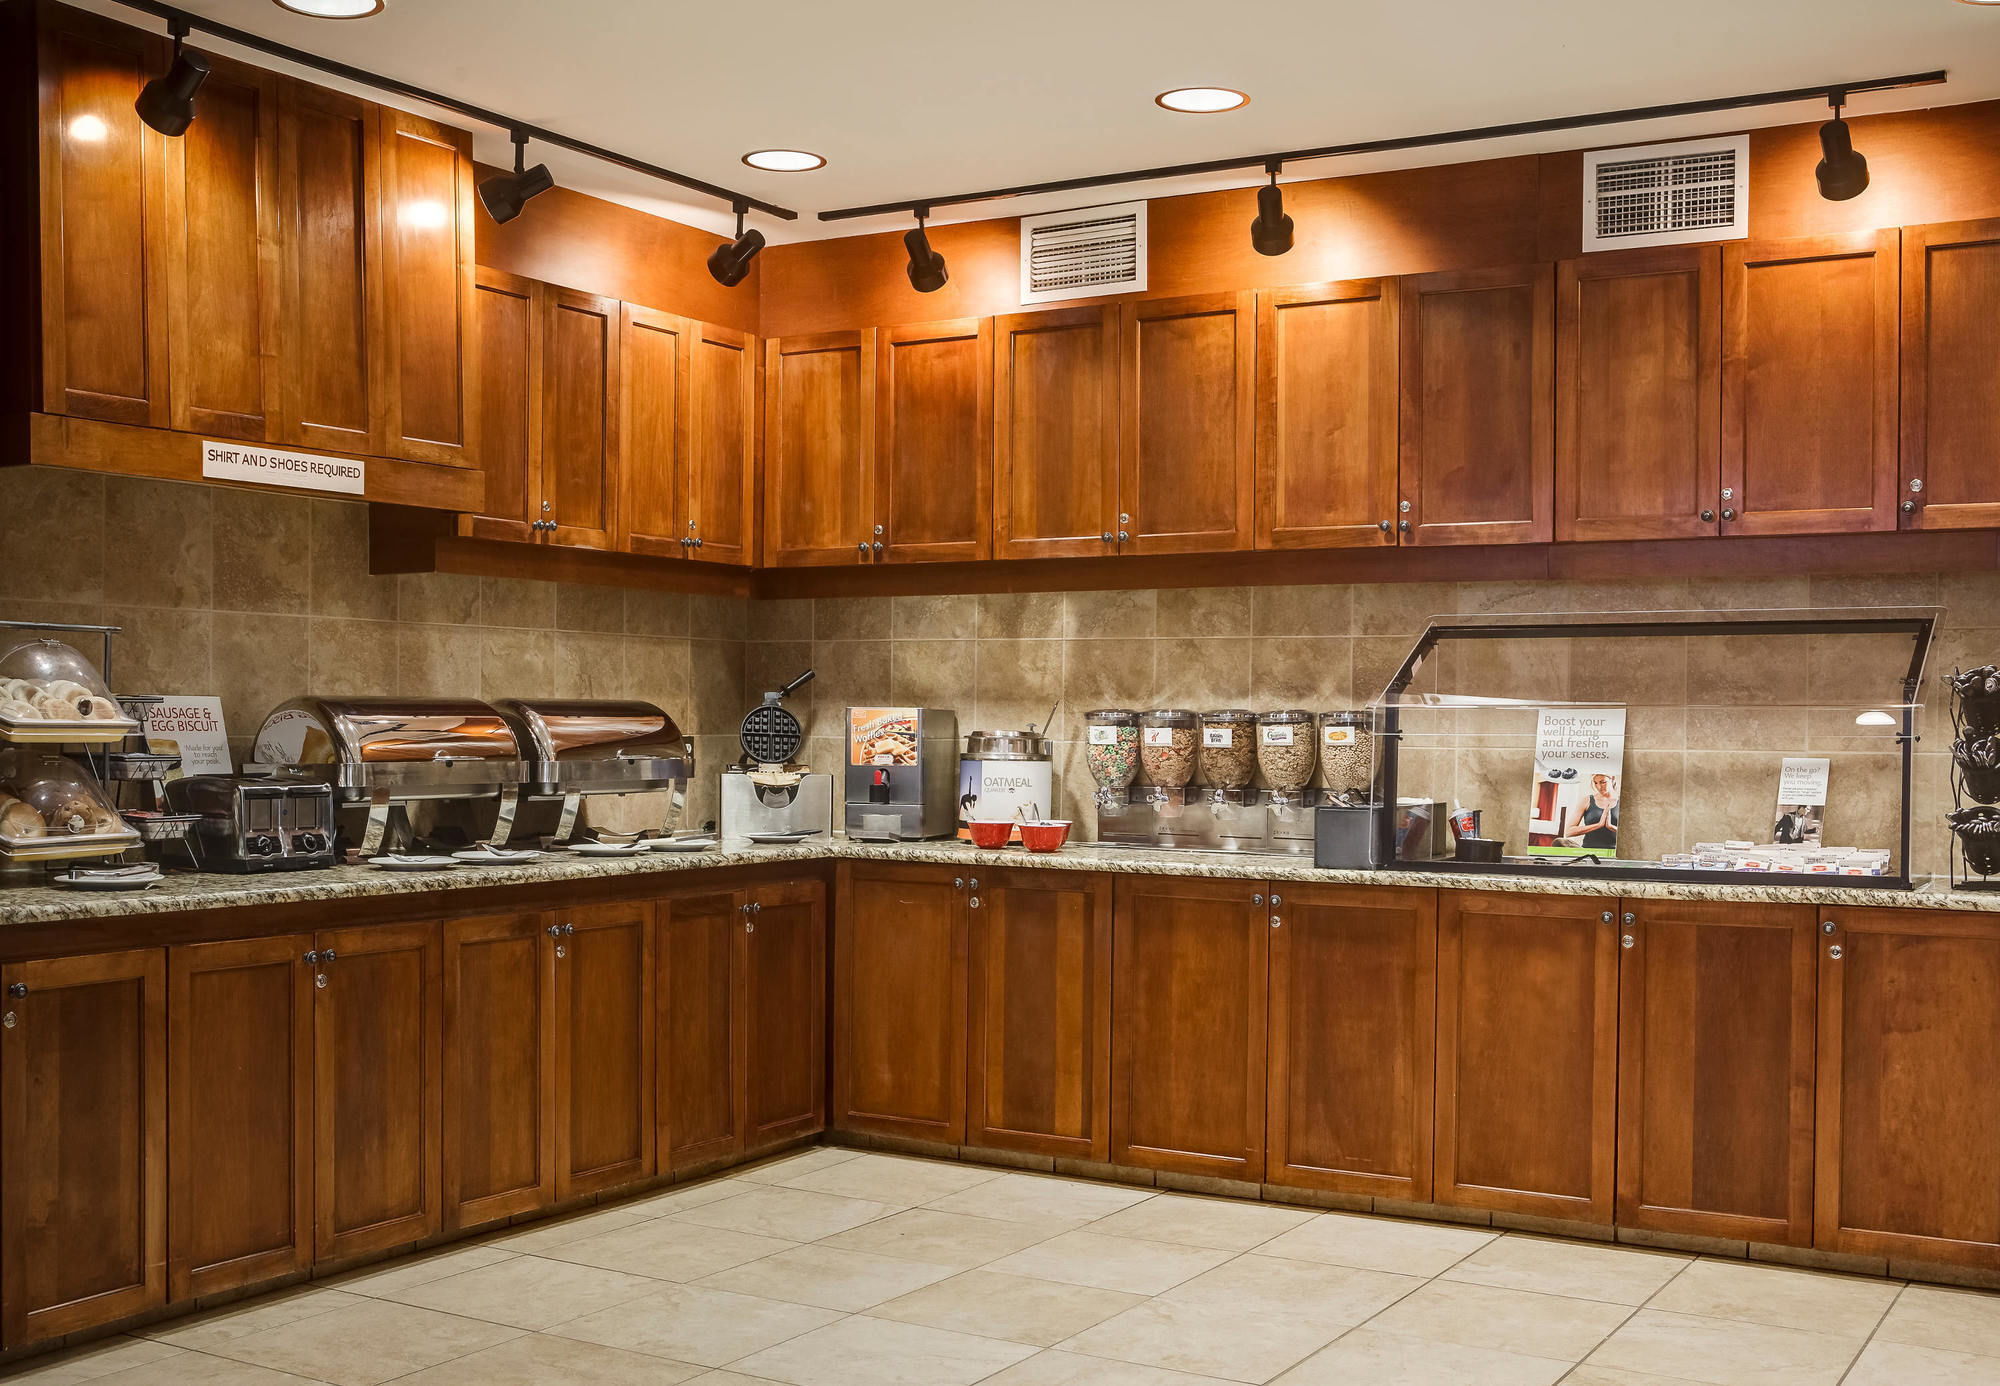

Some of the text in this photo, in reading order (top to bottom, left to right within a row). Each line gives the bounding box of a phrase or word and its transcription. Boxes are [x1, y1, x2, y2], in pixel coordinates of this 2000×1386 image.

[207, 449, 361, 479] SHIRT AND SHOES REQUIRED
[149, 707, 212, 720] SAUSAGE &
[151, 720, 219, 732] EGG BISCUIT
[1544, 715, 1606, 729] Boost your
[1543, 726, 1600, 740] well being
[1542, 737, 1609, 748] and freshen
[1541, 750, 1609, 760] your senses.
[983, 776, 1033, 788] OATMEAL
